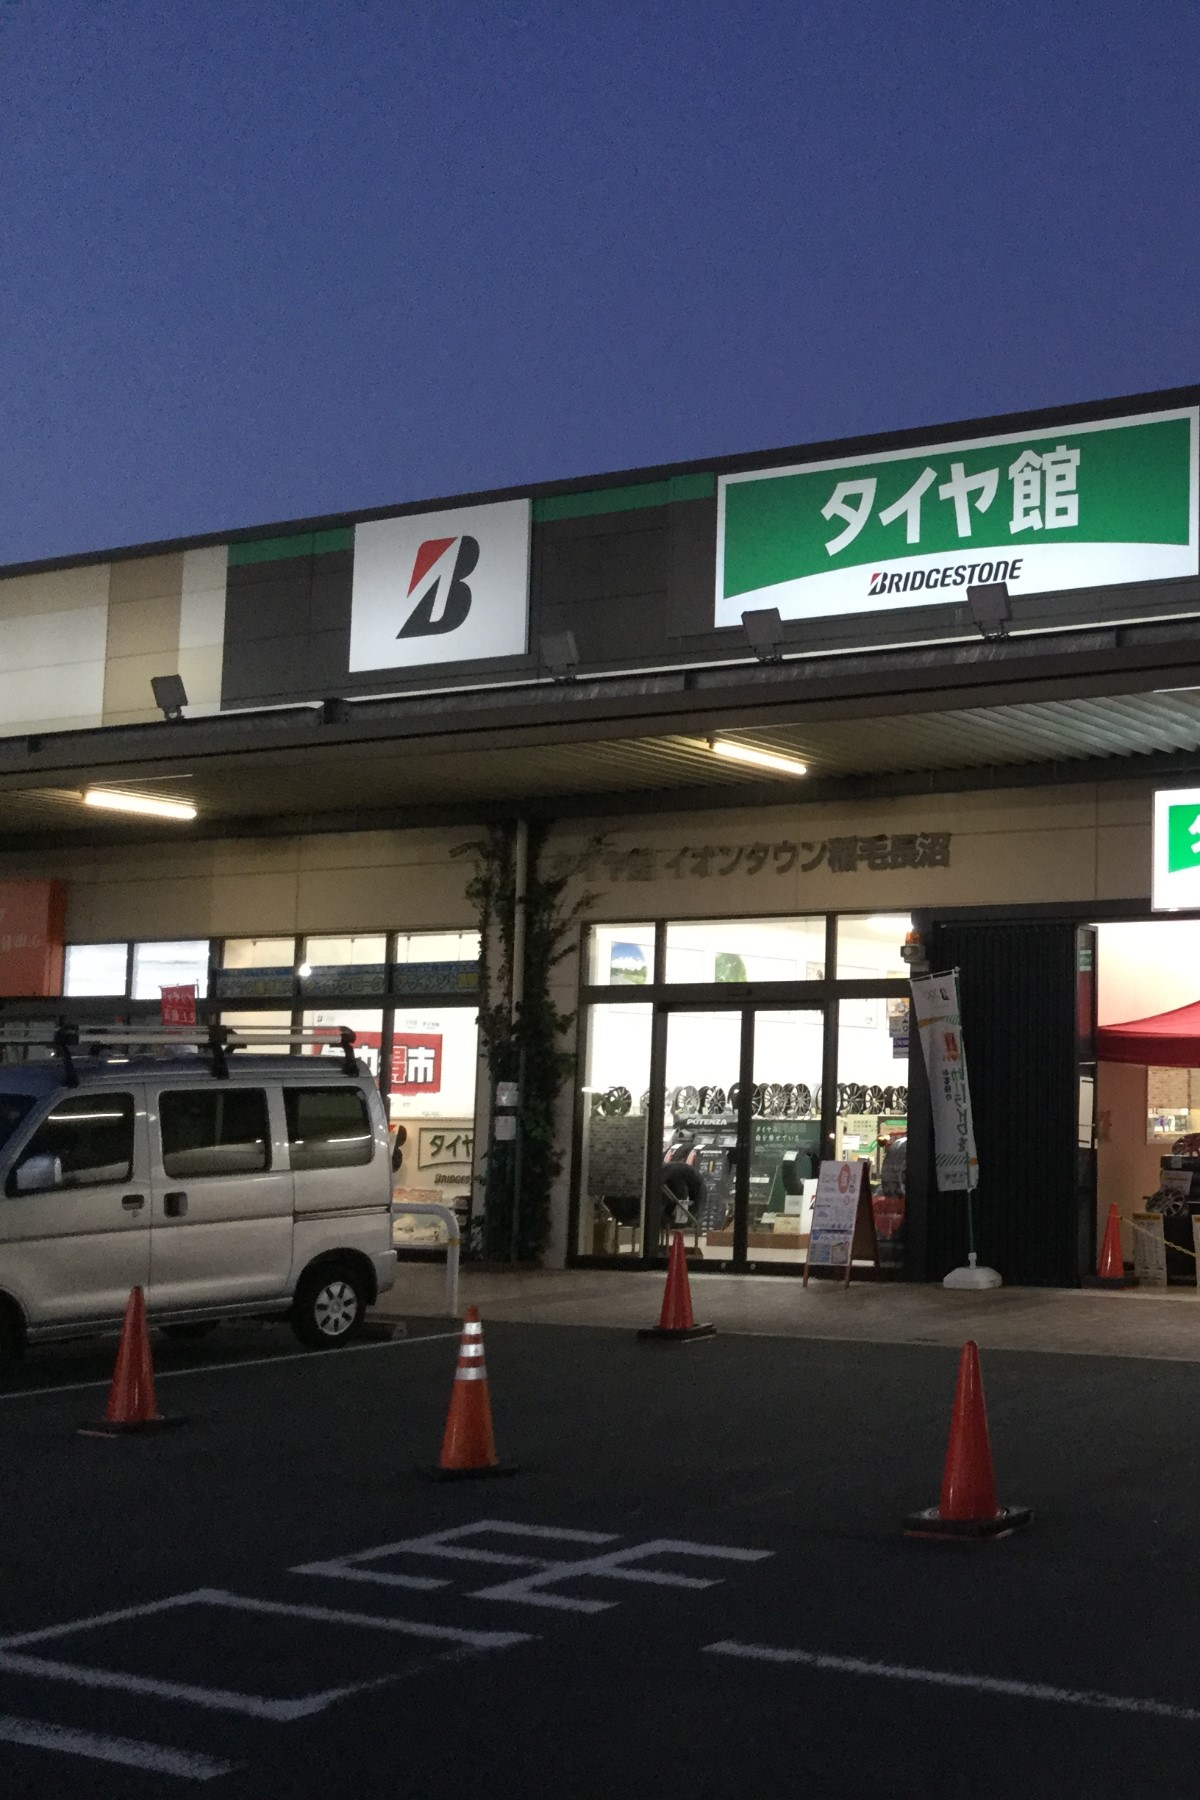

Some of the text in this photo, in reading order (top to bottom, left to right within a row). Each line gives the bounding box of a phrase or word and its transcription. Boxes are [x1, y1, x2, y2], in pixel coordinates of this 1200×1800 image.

[820, 444, 1081, 557] タイヤ館
[868, 558, 1024, 597] BRIDGESTONE
[686, 1118, 728, 1126] POTENZA
